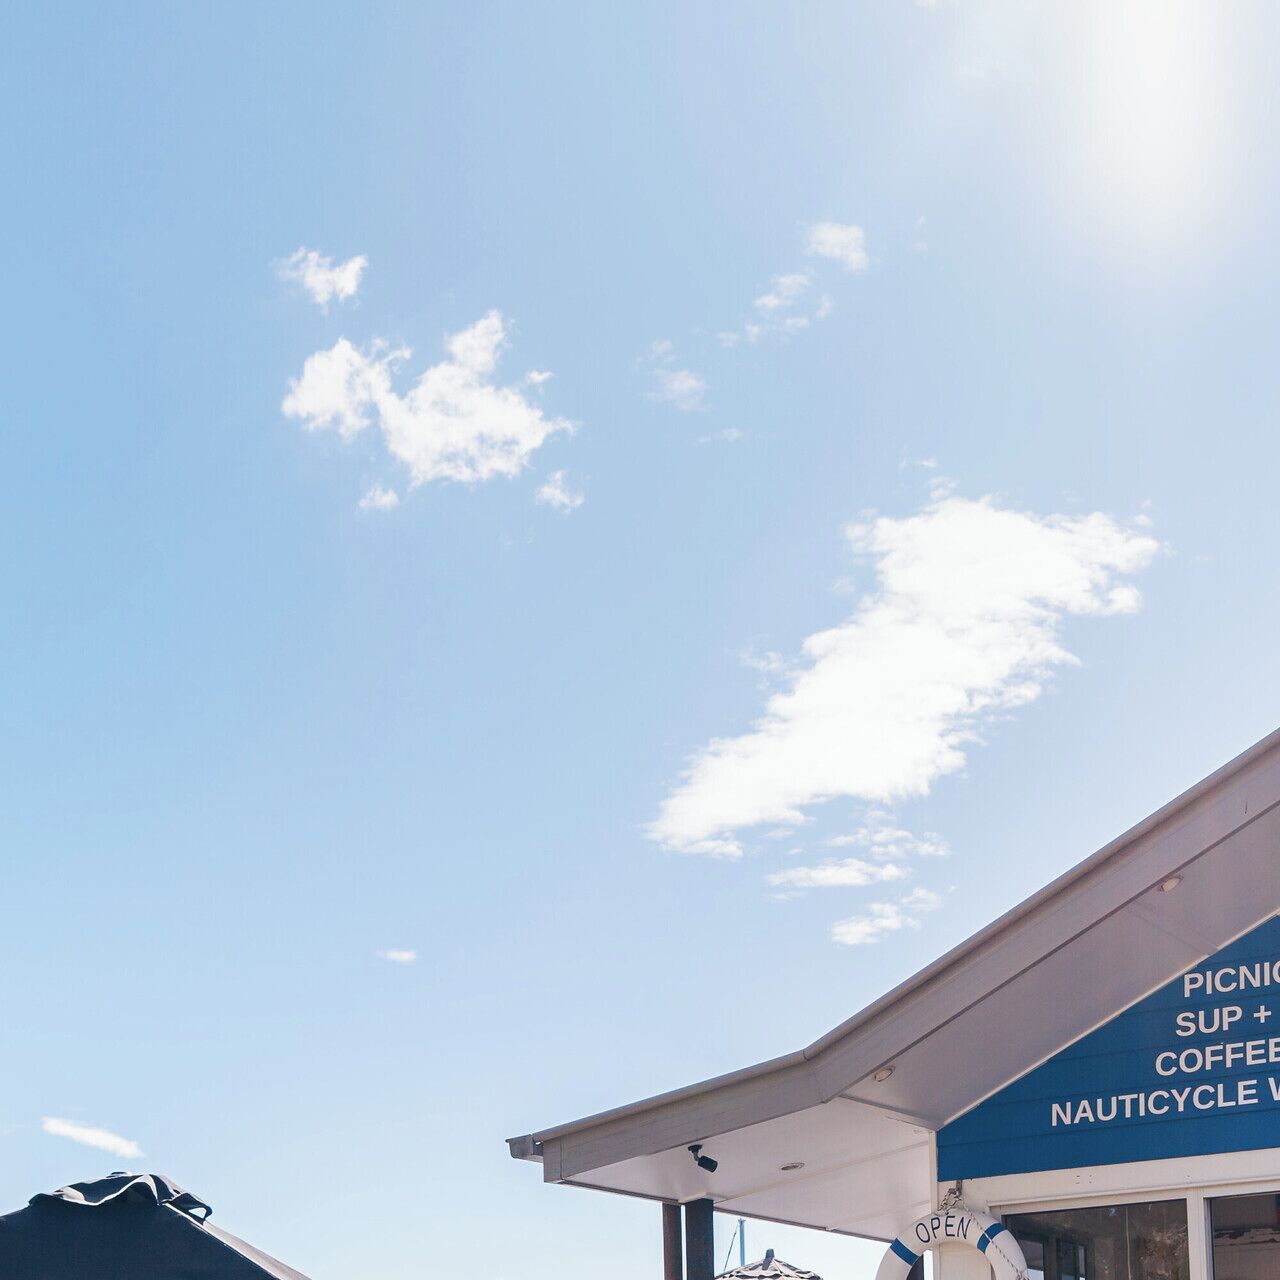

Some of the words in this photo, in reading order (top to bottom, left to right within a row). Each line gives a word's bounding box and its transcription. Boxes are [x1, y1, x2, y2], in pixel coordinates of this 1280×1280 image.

[1176, 1005, 1243, 1037] SUP
[1254, 1005, 1272, 1024] +
[1050, 1079, 1259, 1127] NAUTICYCLE
[915, 1215, 972, 1244] OPEN
